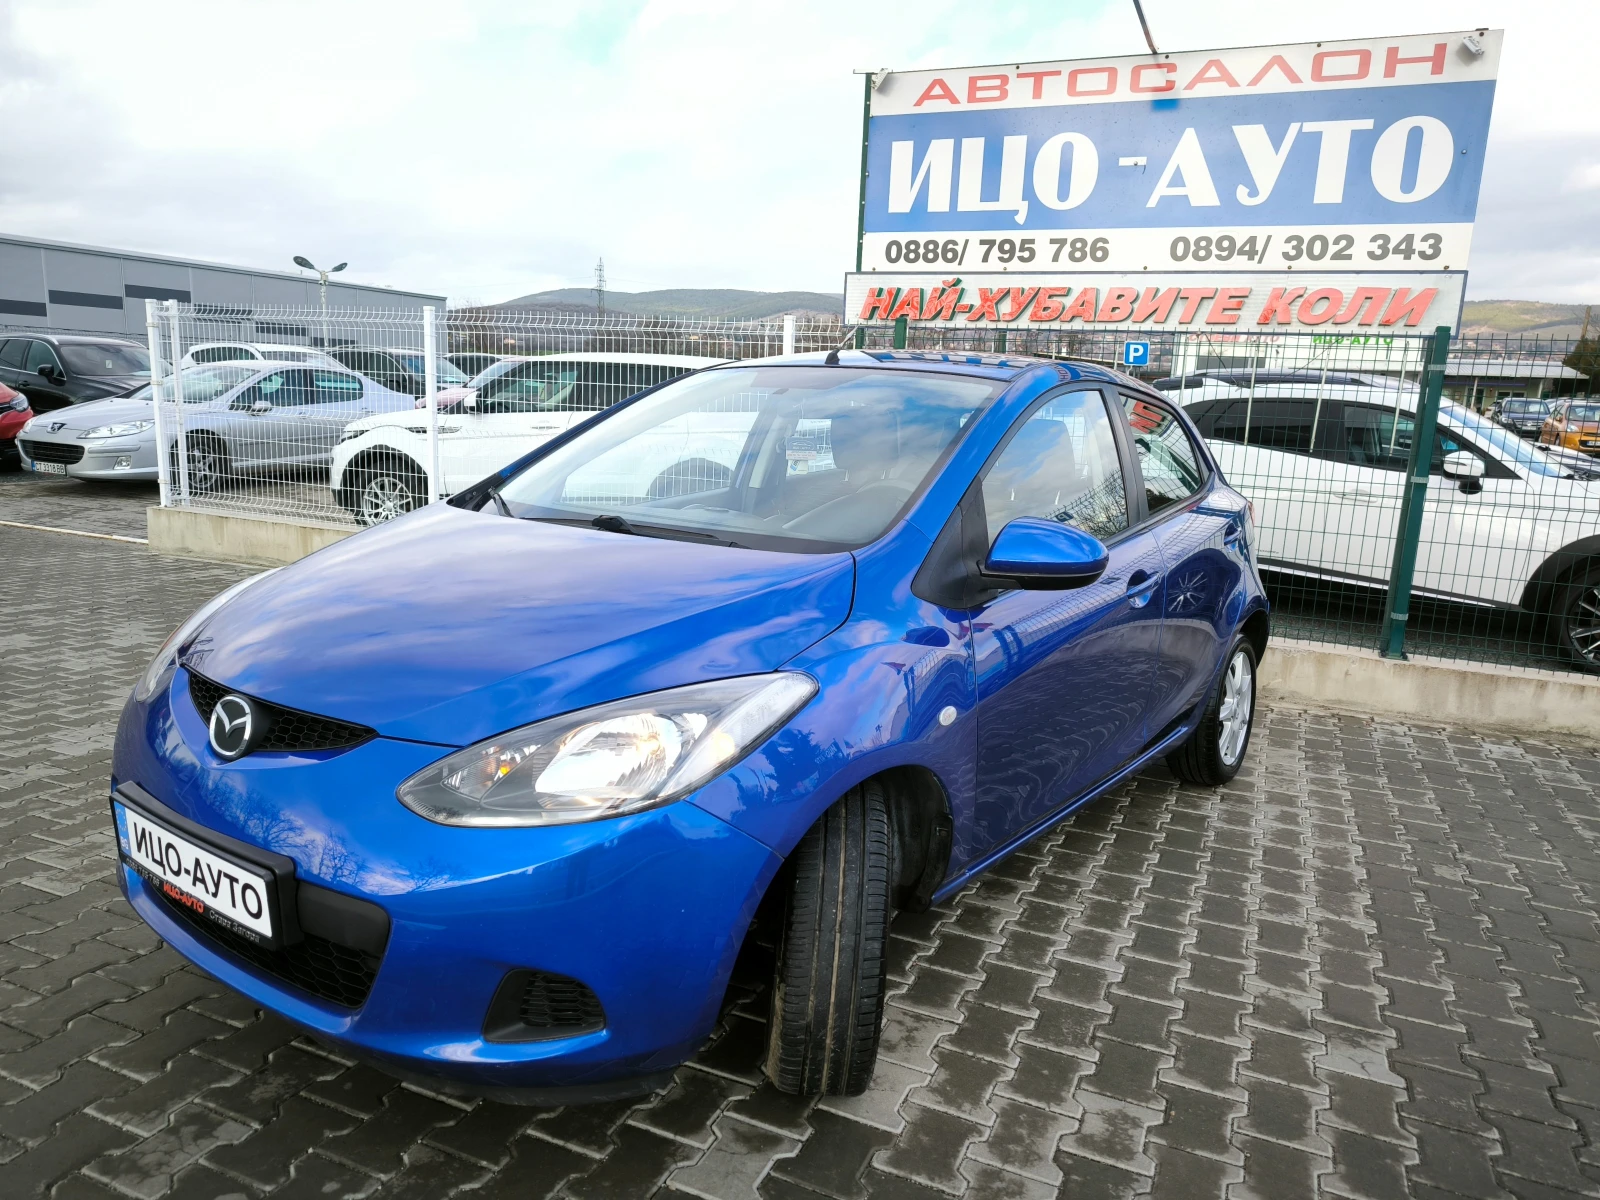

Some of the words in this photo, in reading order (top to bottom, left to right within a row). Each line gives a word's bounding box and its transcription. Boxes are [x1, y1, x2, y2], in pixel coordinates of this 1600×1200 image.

[913, 42, 1447, 107] АВТОСАЛОН
[885, 239, 970, 265] 0886/
[978, 238, 1036, 263] 795
[1049, 237, 1110, 263] 786
[1169, 234, 1272, 264] 0894/
[1281, 234, 1355, 261] 302
[1366, 233, 1443, 261] 343
[858, 277, 1252, 324] НАЙ-ХУБАВИТЕ
[1256, 286, 1440, 326] КОЛИ
[1129, 344, 1144, 363] P
[133, 821, 263, 920] ИЦО-АУТО
[163, 881, 205, 914] ИЦО-АУТО
[209, 909, 232, 929] Стара
[231, 921, 261, 943] Загора
